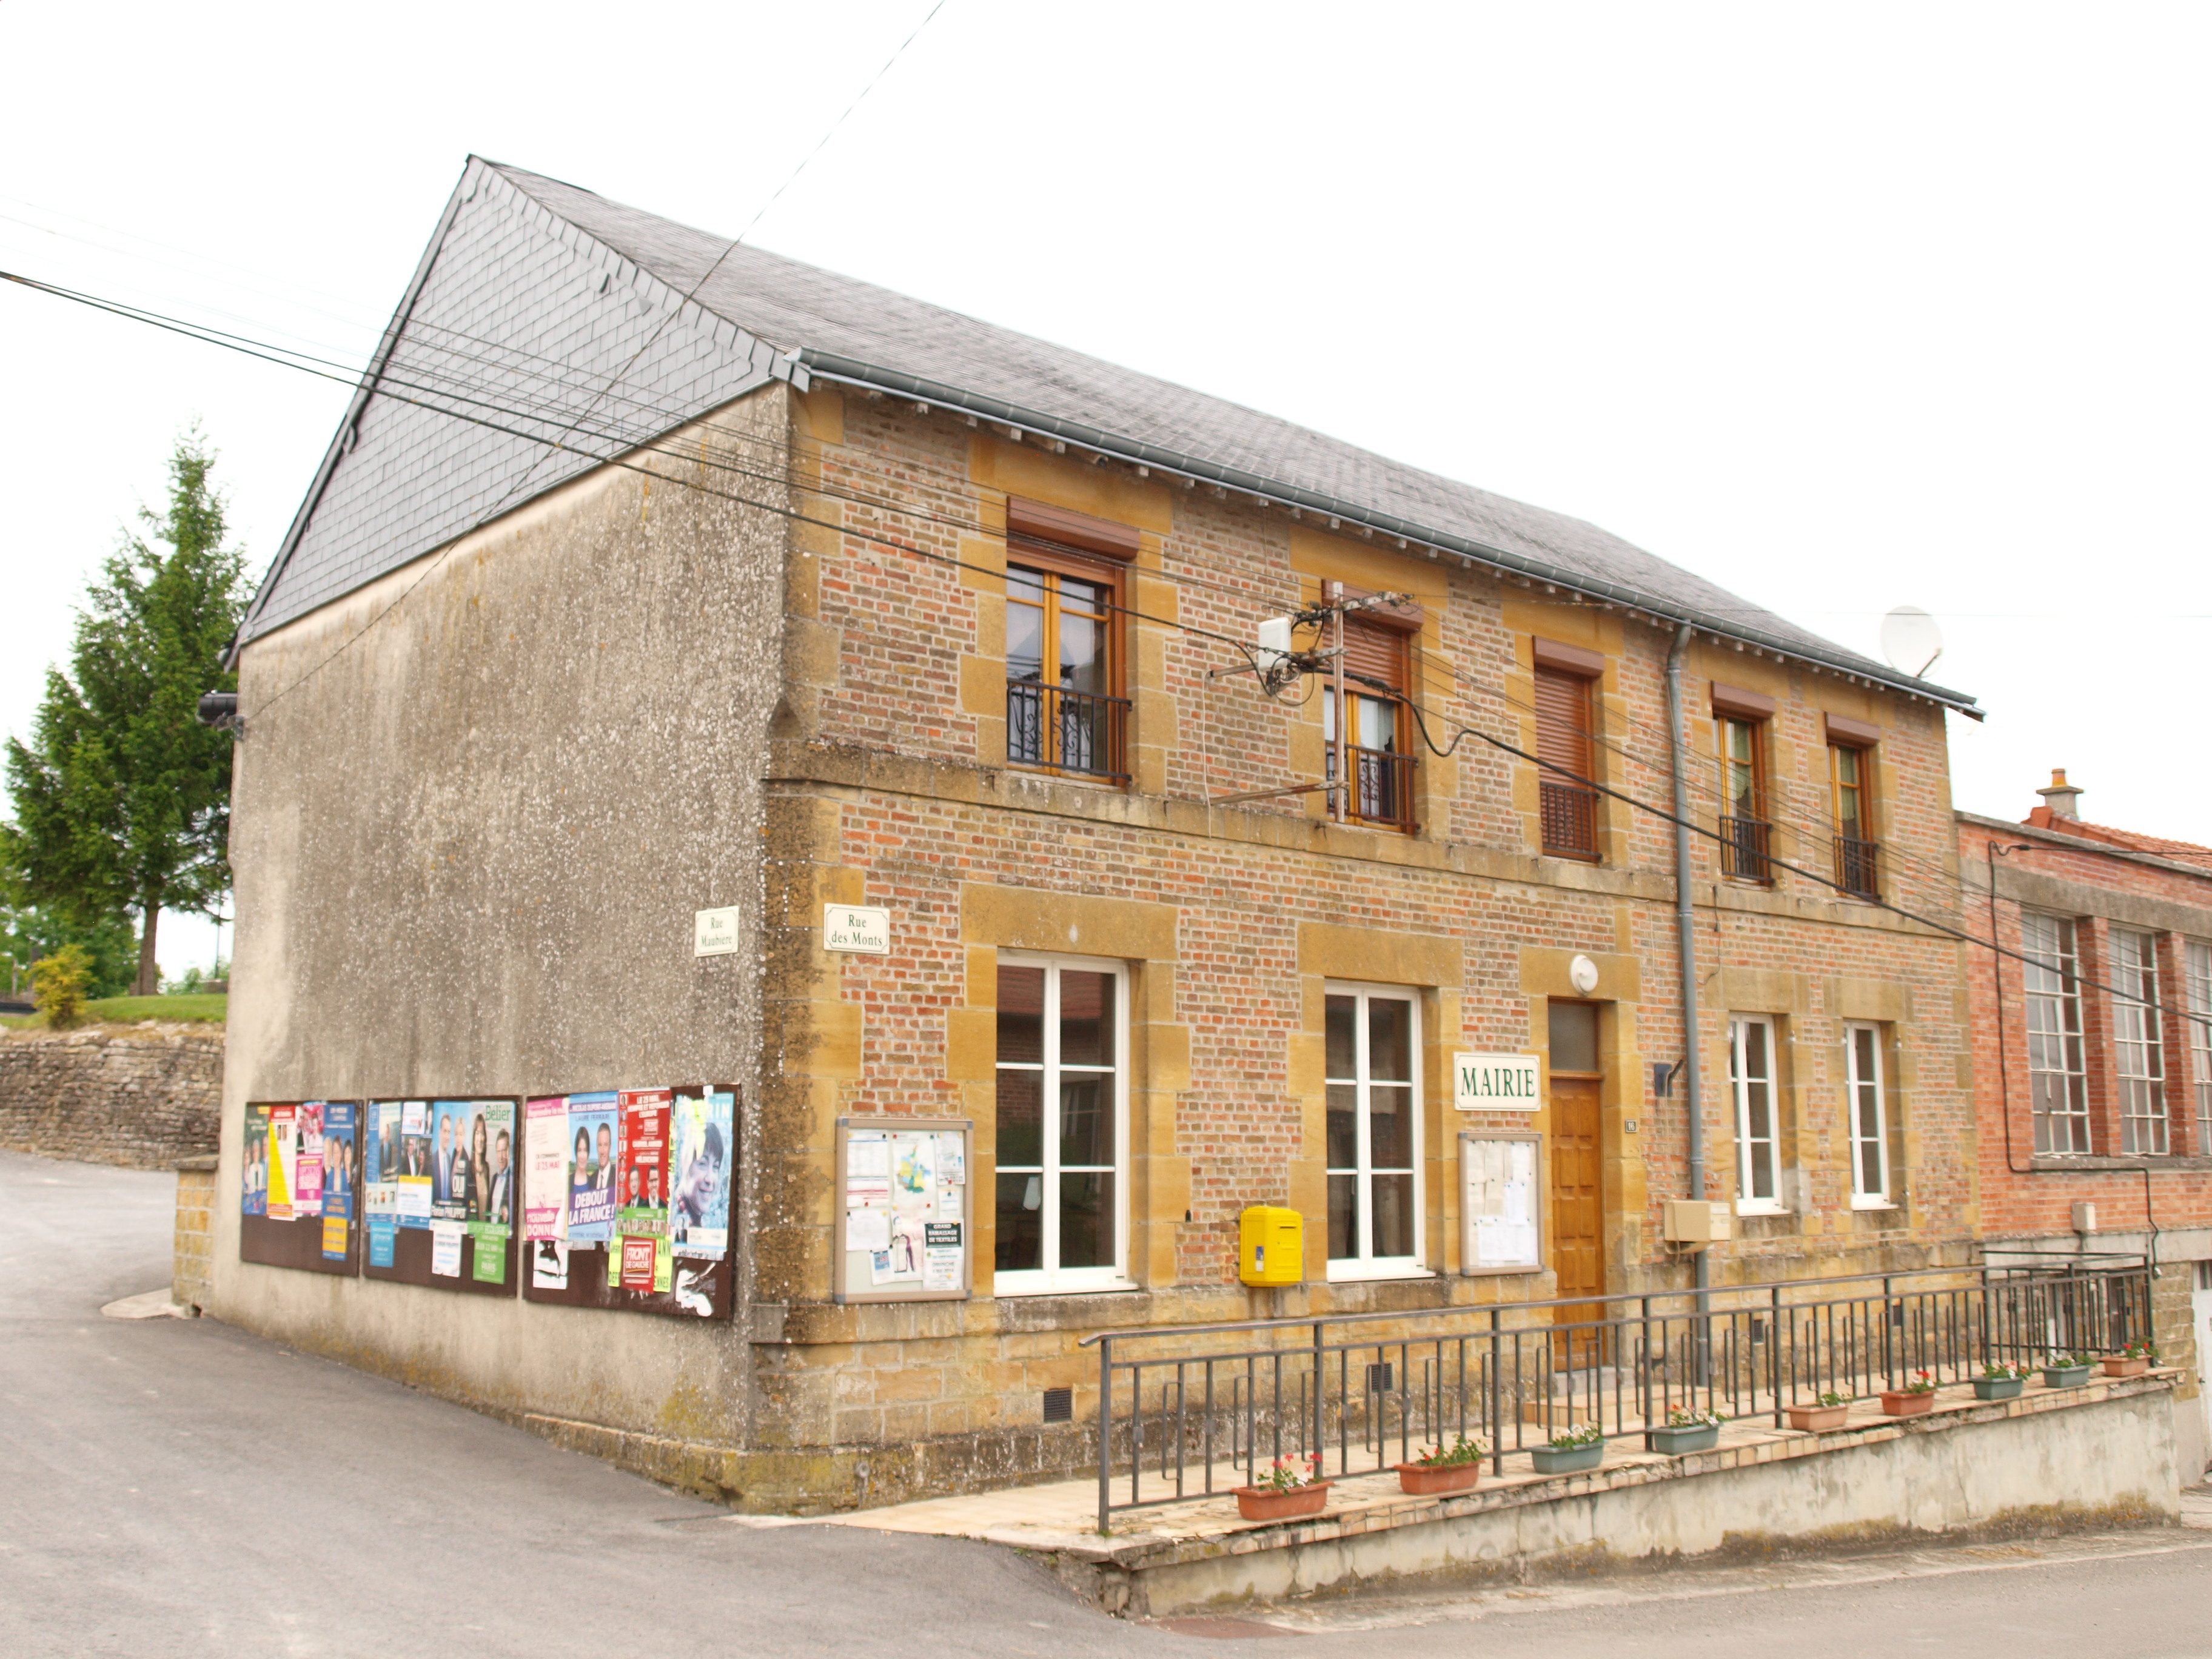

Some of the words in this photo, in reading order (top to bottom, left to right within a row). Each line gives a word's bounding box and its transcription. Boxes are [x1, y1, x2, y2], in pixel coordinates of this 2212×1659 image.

[711, 917, 723, 929] Rue
[848, 914, 866, 928] Rue
[701, 934, 732, 947] Maubière
[831, 931, 848, 943] des
[851, 932, 882, 946] Monts
[1461, 1067, 1535, 1097] MAIRIE
[485, 1105, 511, 1122] Bélier
[452, 1176, 465, 1193] OUI
[575, 1189, 609, 1208] DEBOUT
[526, 1210, 555, 1224] nouvelle
[569, 1211, 578, 1225] LA
[580, 1205, 611, 1224] FRANCE
[626, 1247, 651, 1261] FRONT
